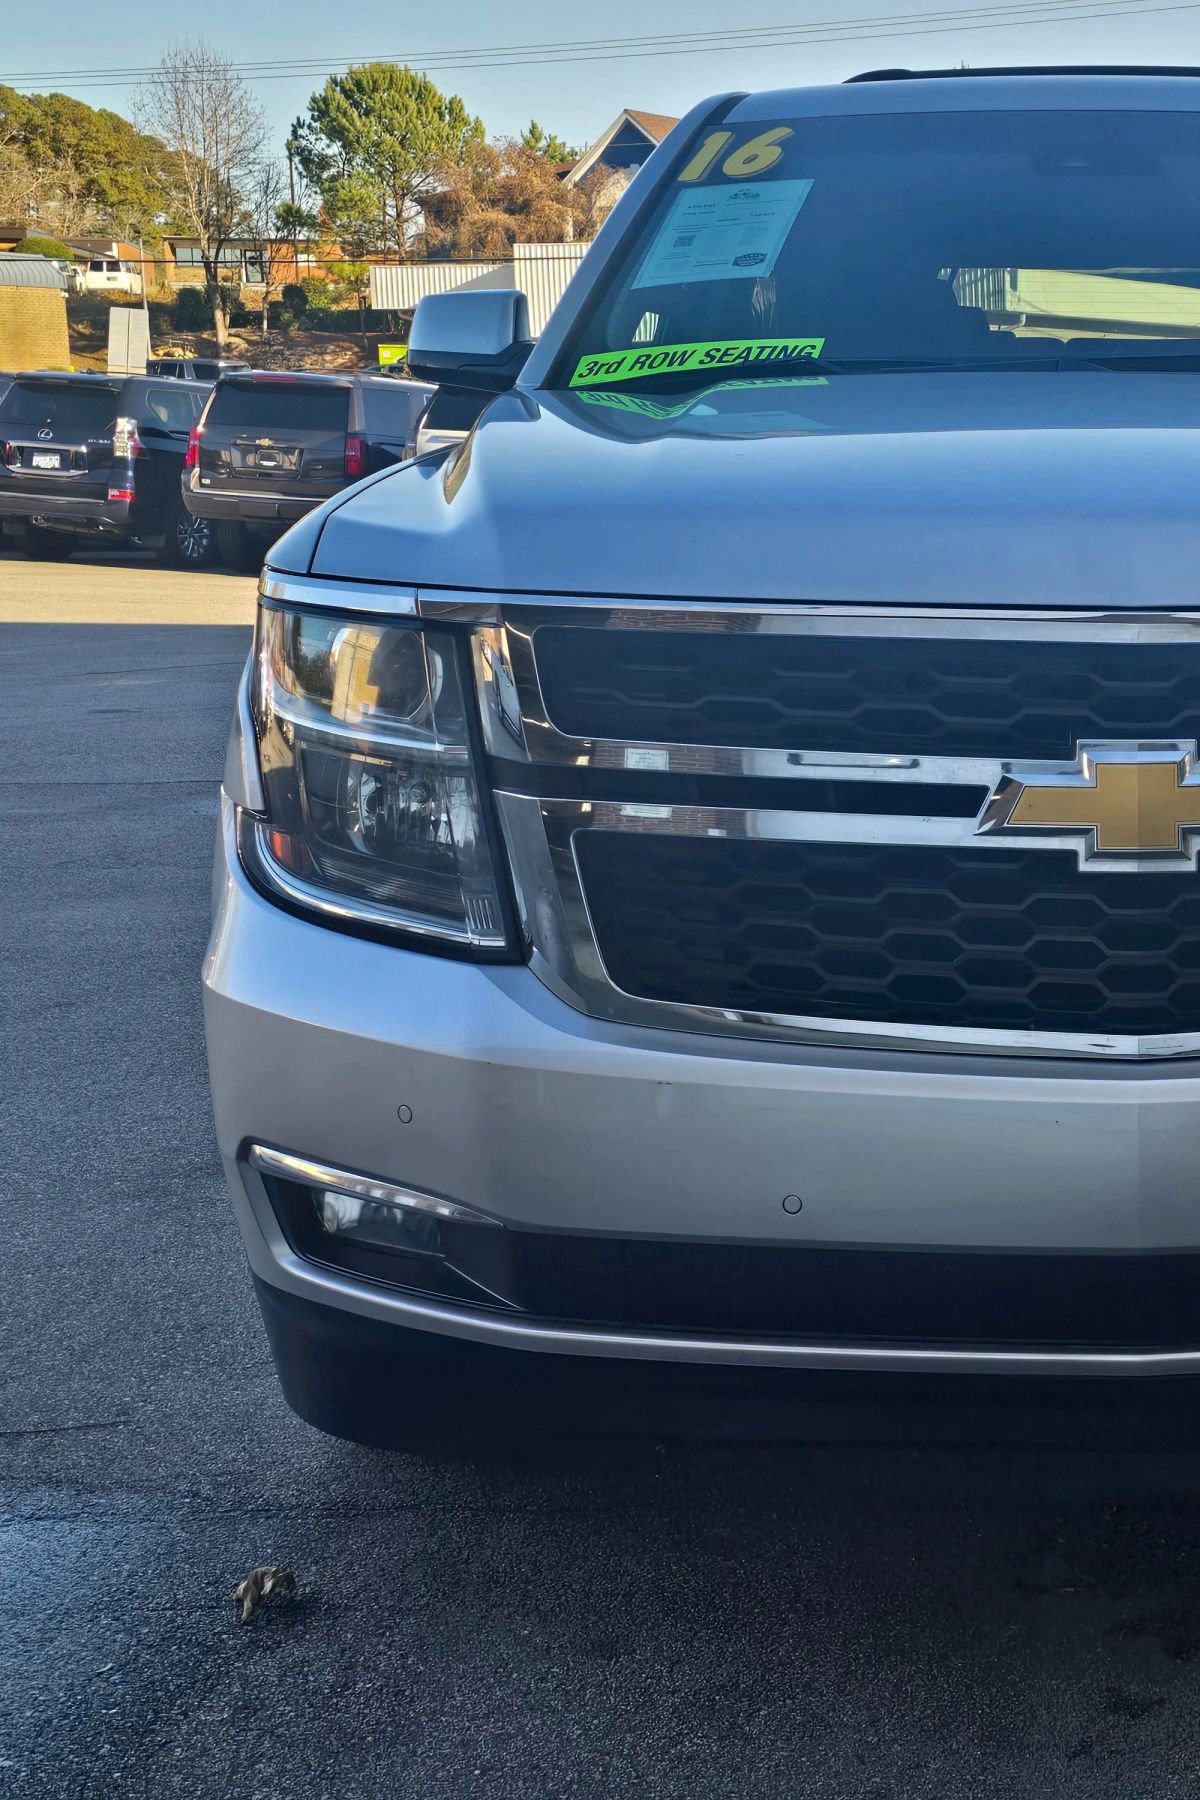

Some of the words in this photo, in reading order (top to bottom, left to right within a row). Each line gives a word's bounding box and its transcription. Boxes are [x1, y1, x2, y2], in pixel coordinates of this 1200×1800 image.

[677, 126, 794, 182] 16
[578, 356, 626, 378] 3rd
[628, 349, 698, 372] ROW
[699, 343, 817, 365] SEATING
